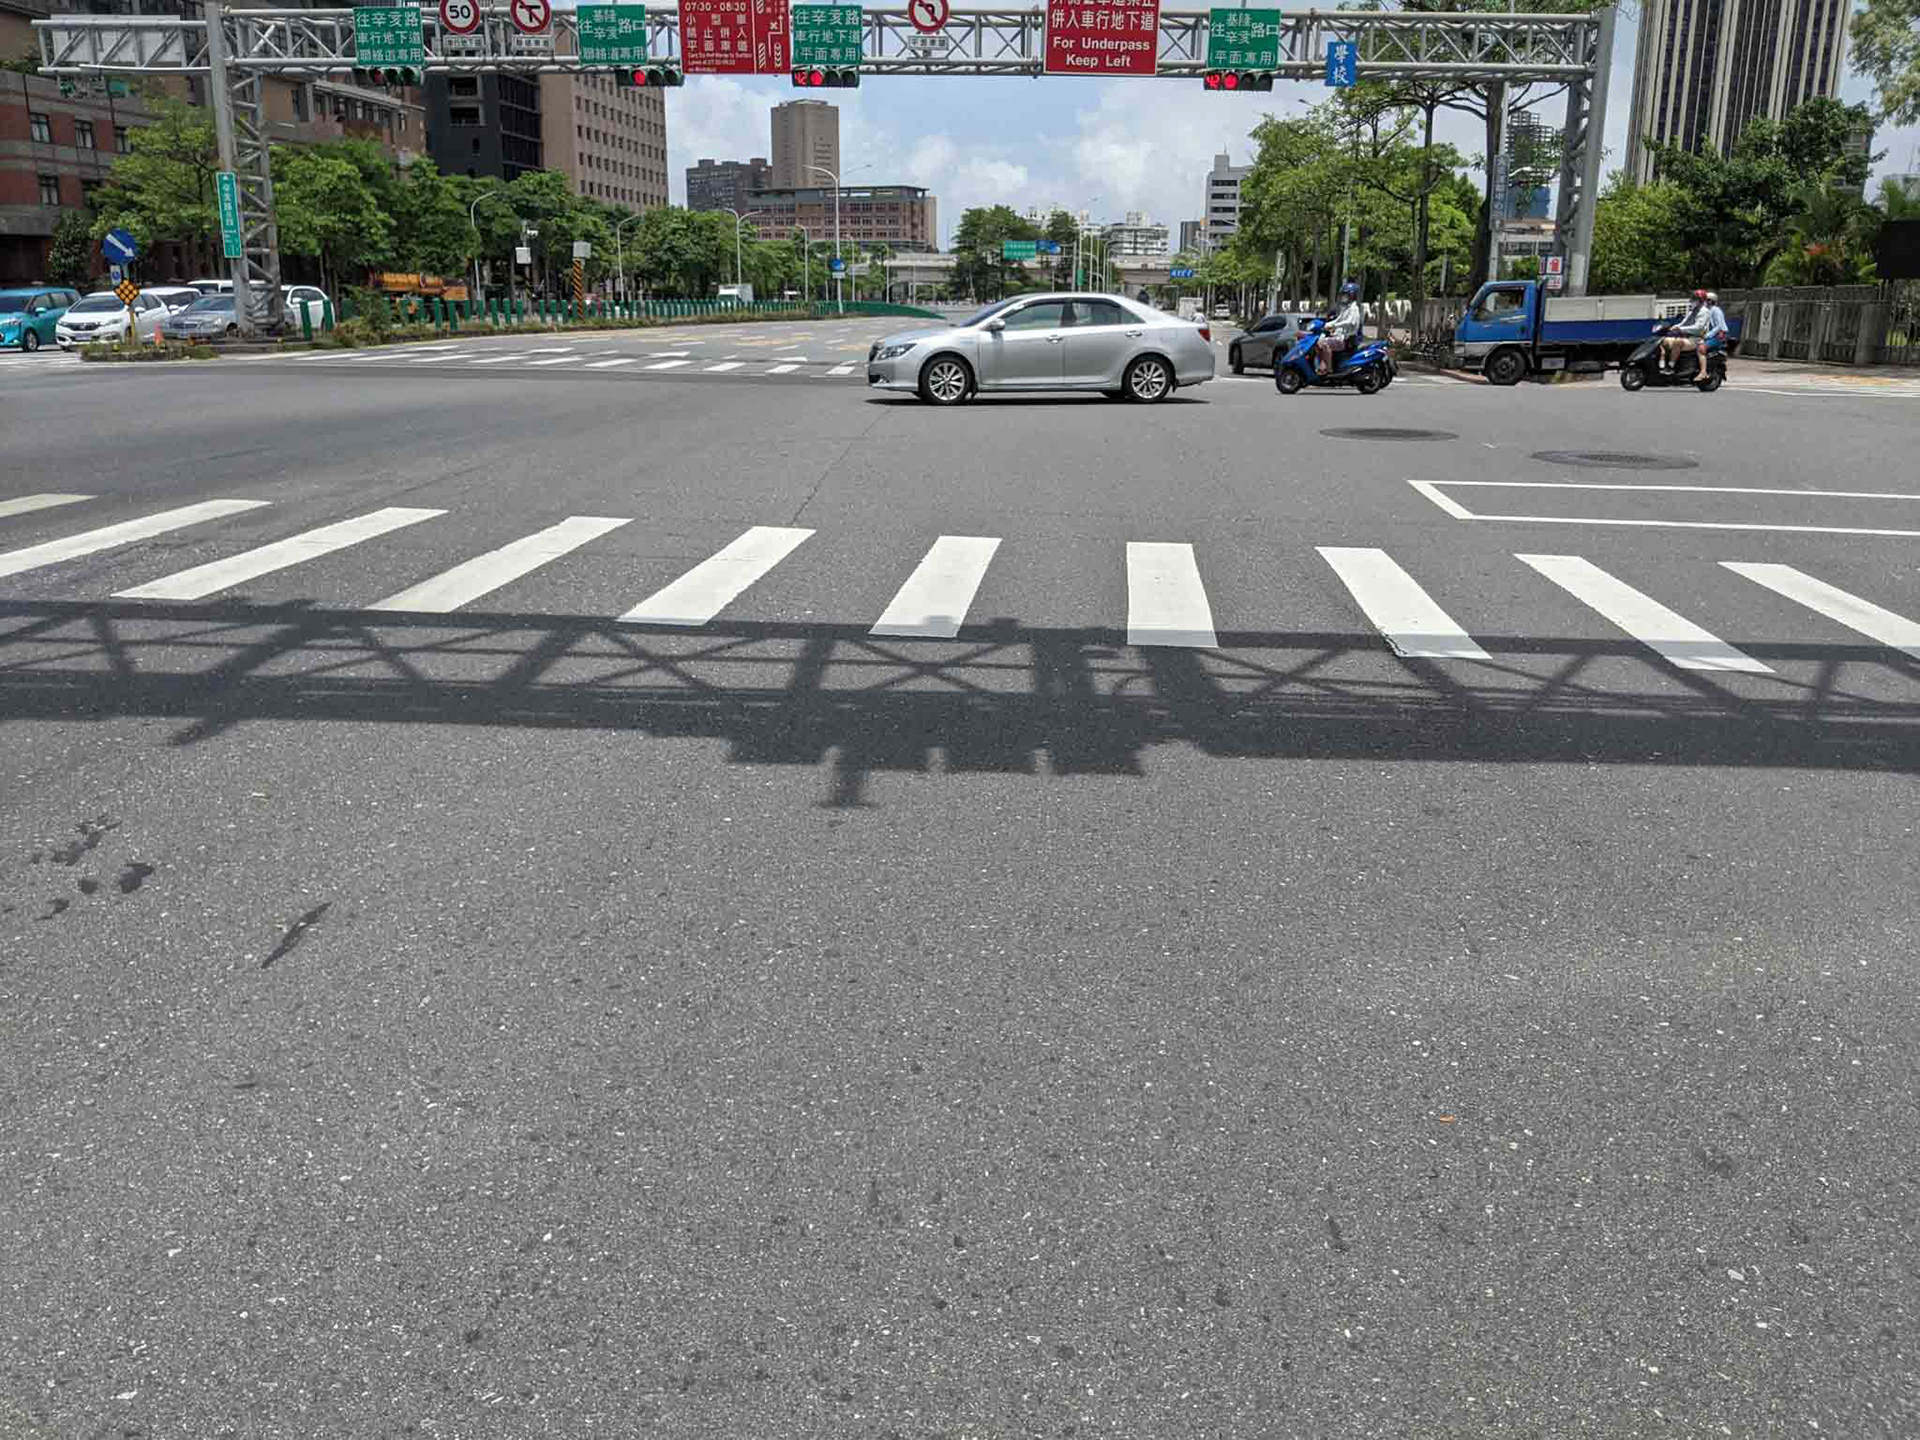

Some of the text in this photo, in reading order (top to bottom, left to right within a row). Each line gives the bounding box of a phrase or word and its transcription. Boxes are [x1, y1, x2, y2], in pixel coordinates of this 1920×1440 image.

[449, 5, 471, 19] 50
[684, 2, 712, 12] 07:30
[719, 2, 746, 12] 08:30
[356, 11, 419, 28] 往辛亥路
[794, 8, 860, 26] 往辛亥路
[1051, 9, 1155, 31] 併入車行地下道
[1226, 12, 1252, 27] 基隆
[579, 16, 645, 35] 往 路口
[593, 25, 619, 40] 辛亥
[1211, 22, 1279, 38] 往 路口
[357, 30, 421, 45] 車行地下道
[794, 29, 861, 45] 車行地下道
[1053, 37, 1151, 52] For Underpass
[1225, 30, 1251, 45] 辛亥
[686, 40, 748, 52] 平面車道
[1065, 53, 1132, 68] Keep Left
[1333, 44, 1350, 84] 學校
